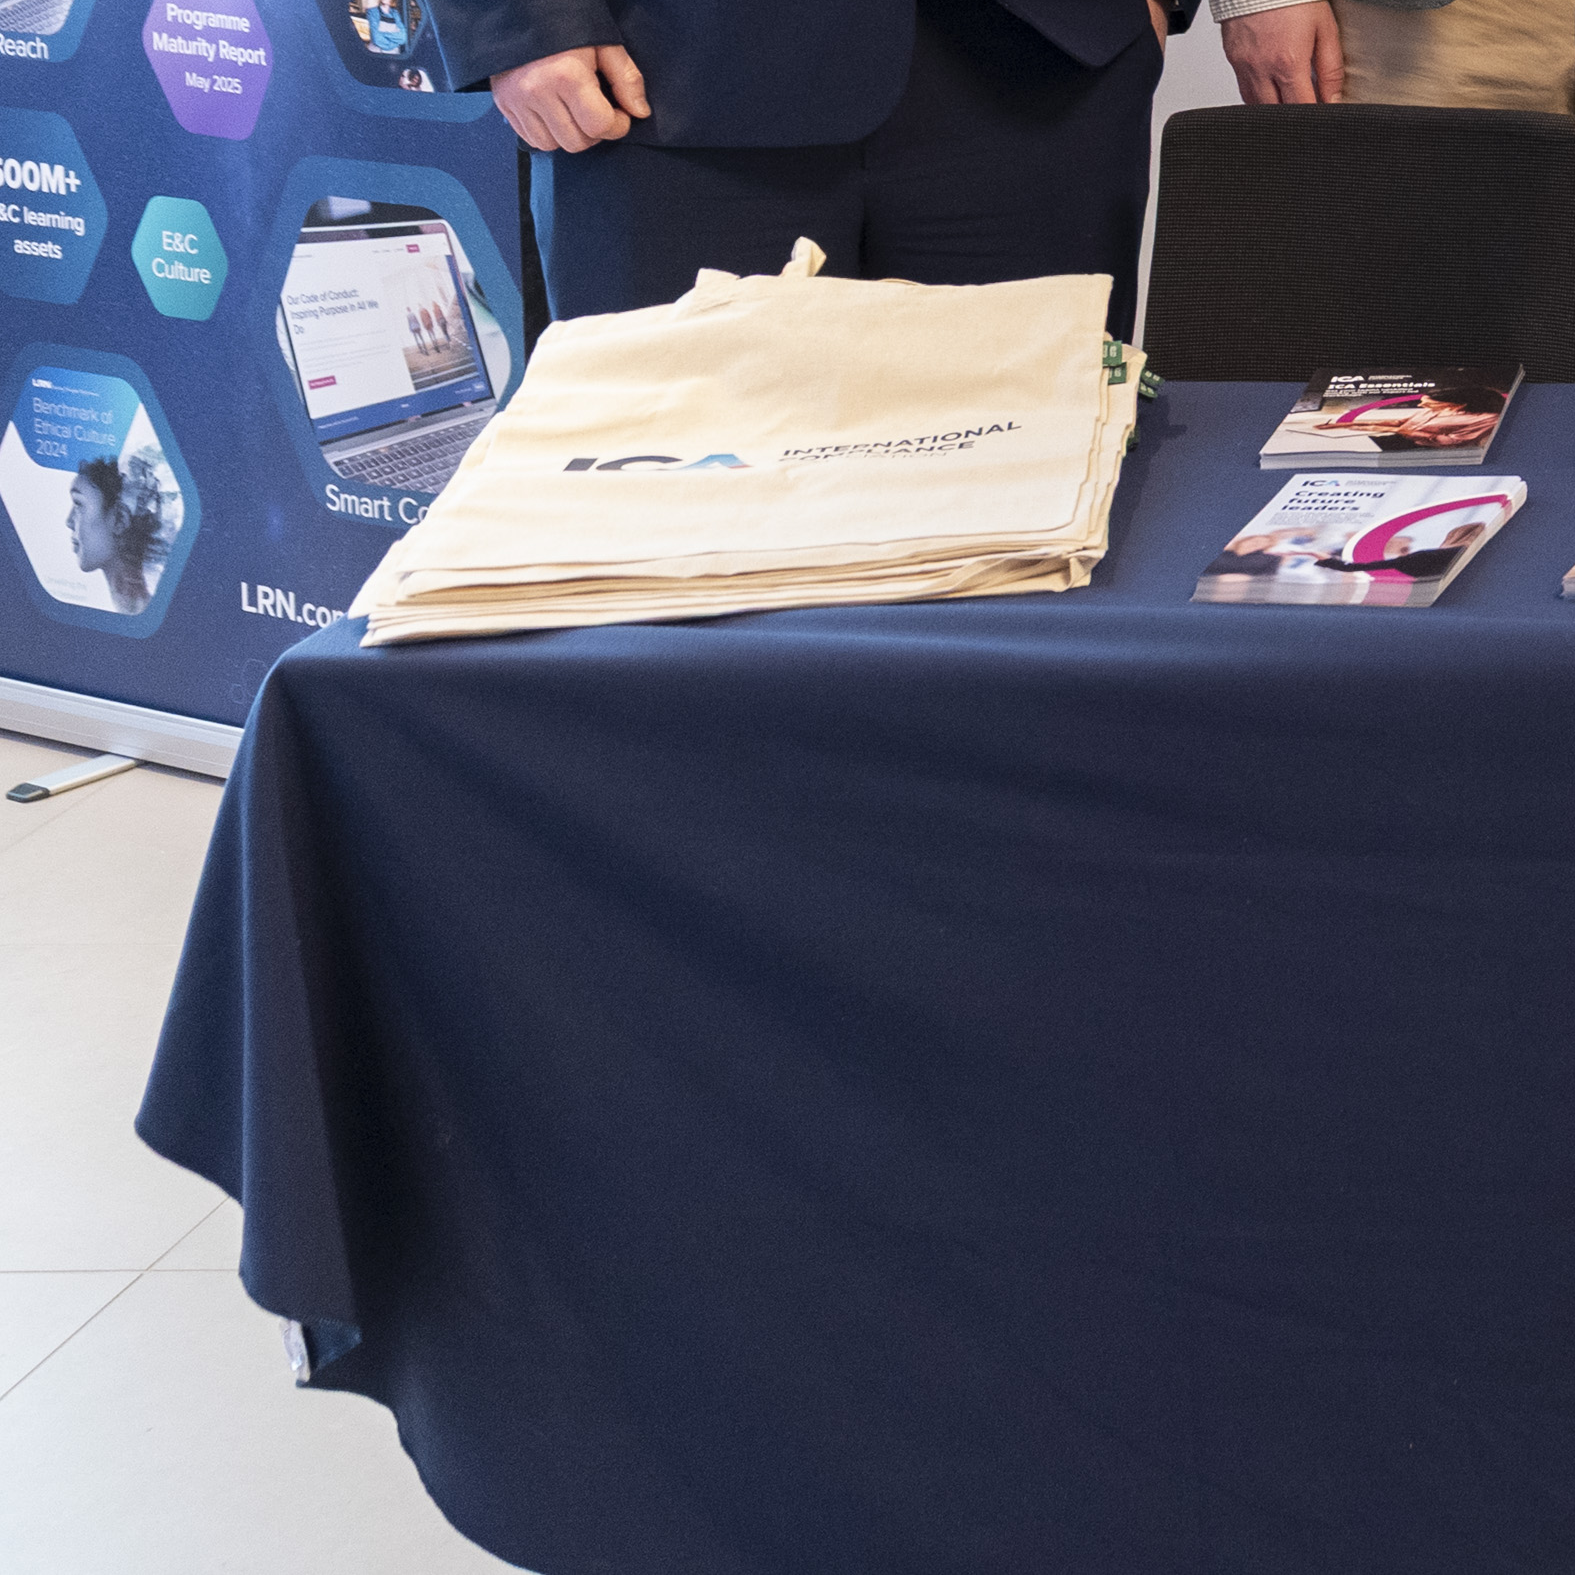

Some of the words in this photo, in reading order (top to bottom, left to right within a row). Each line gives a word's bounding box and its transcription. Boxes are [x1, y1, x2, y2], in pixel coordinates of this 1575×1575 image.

[166, 3, 250, 33] Programme
[152, 31, 216, 62] Maturity
[218, 40, 268, 66] Report
[185, 71, 211, 93] May
[212, 75, 243, 95] 2025
[23, 206, 85, 237] learning
[14, 238, 63, 260] assets
[161, 230, 199, 255] E&C
[151, 257, 212, 284] Culture
[33, 397, 99, 423] Benchmark
[34, 417, 72, 439] Ethical
[74, 425, 116, 447] Culture
[36, 438, 67, 458] 2024
[325, 483, 393, 521] Smart
